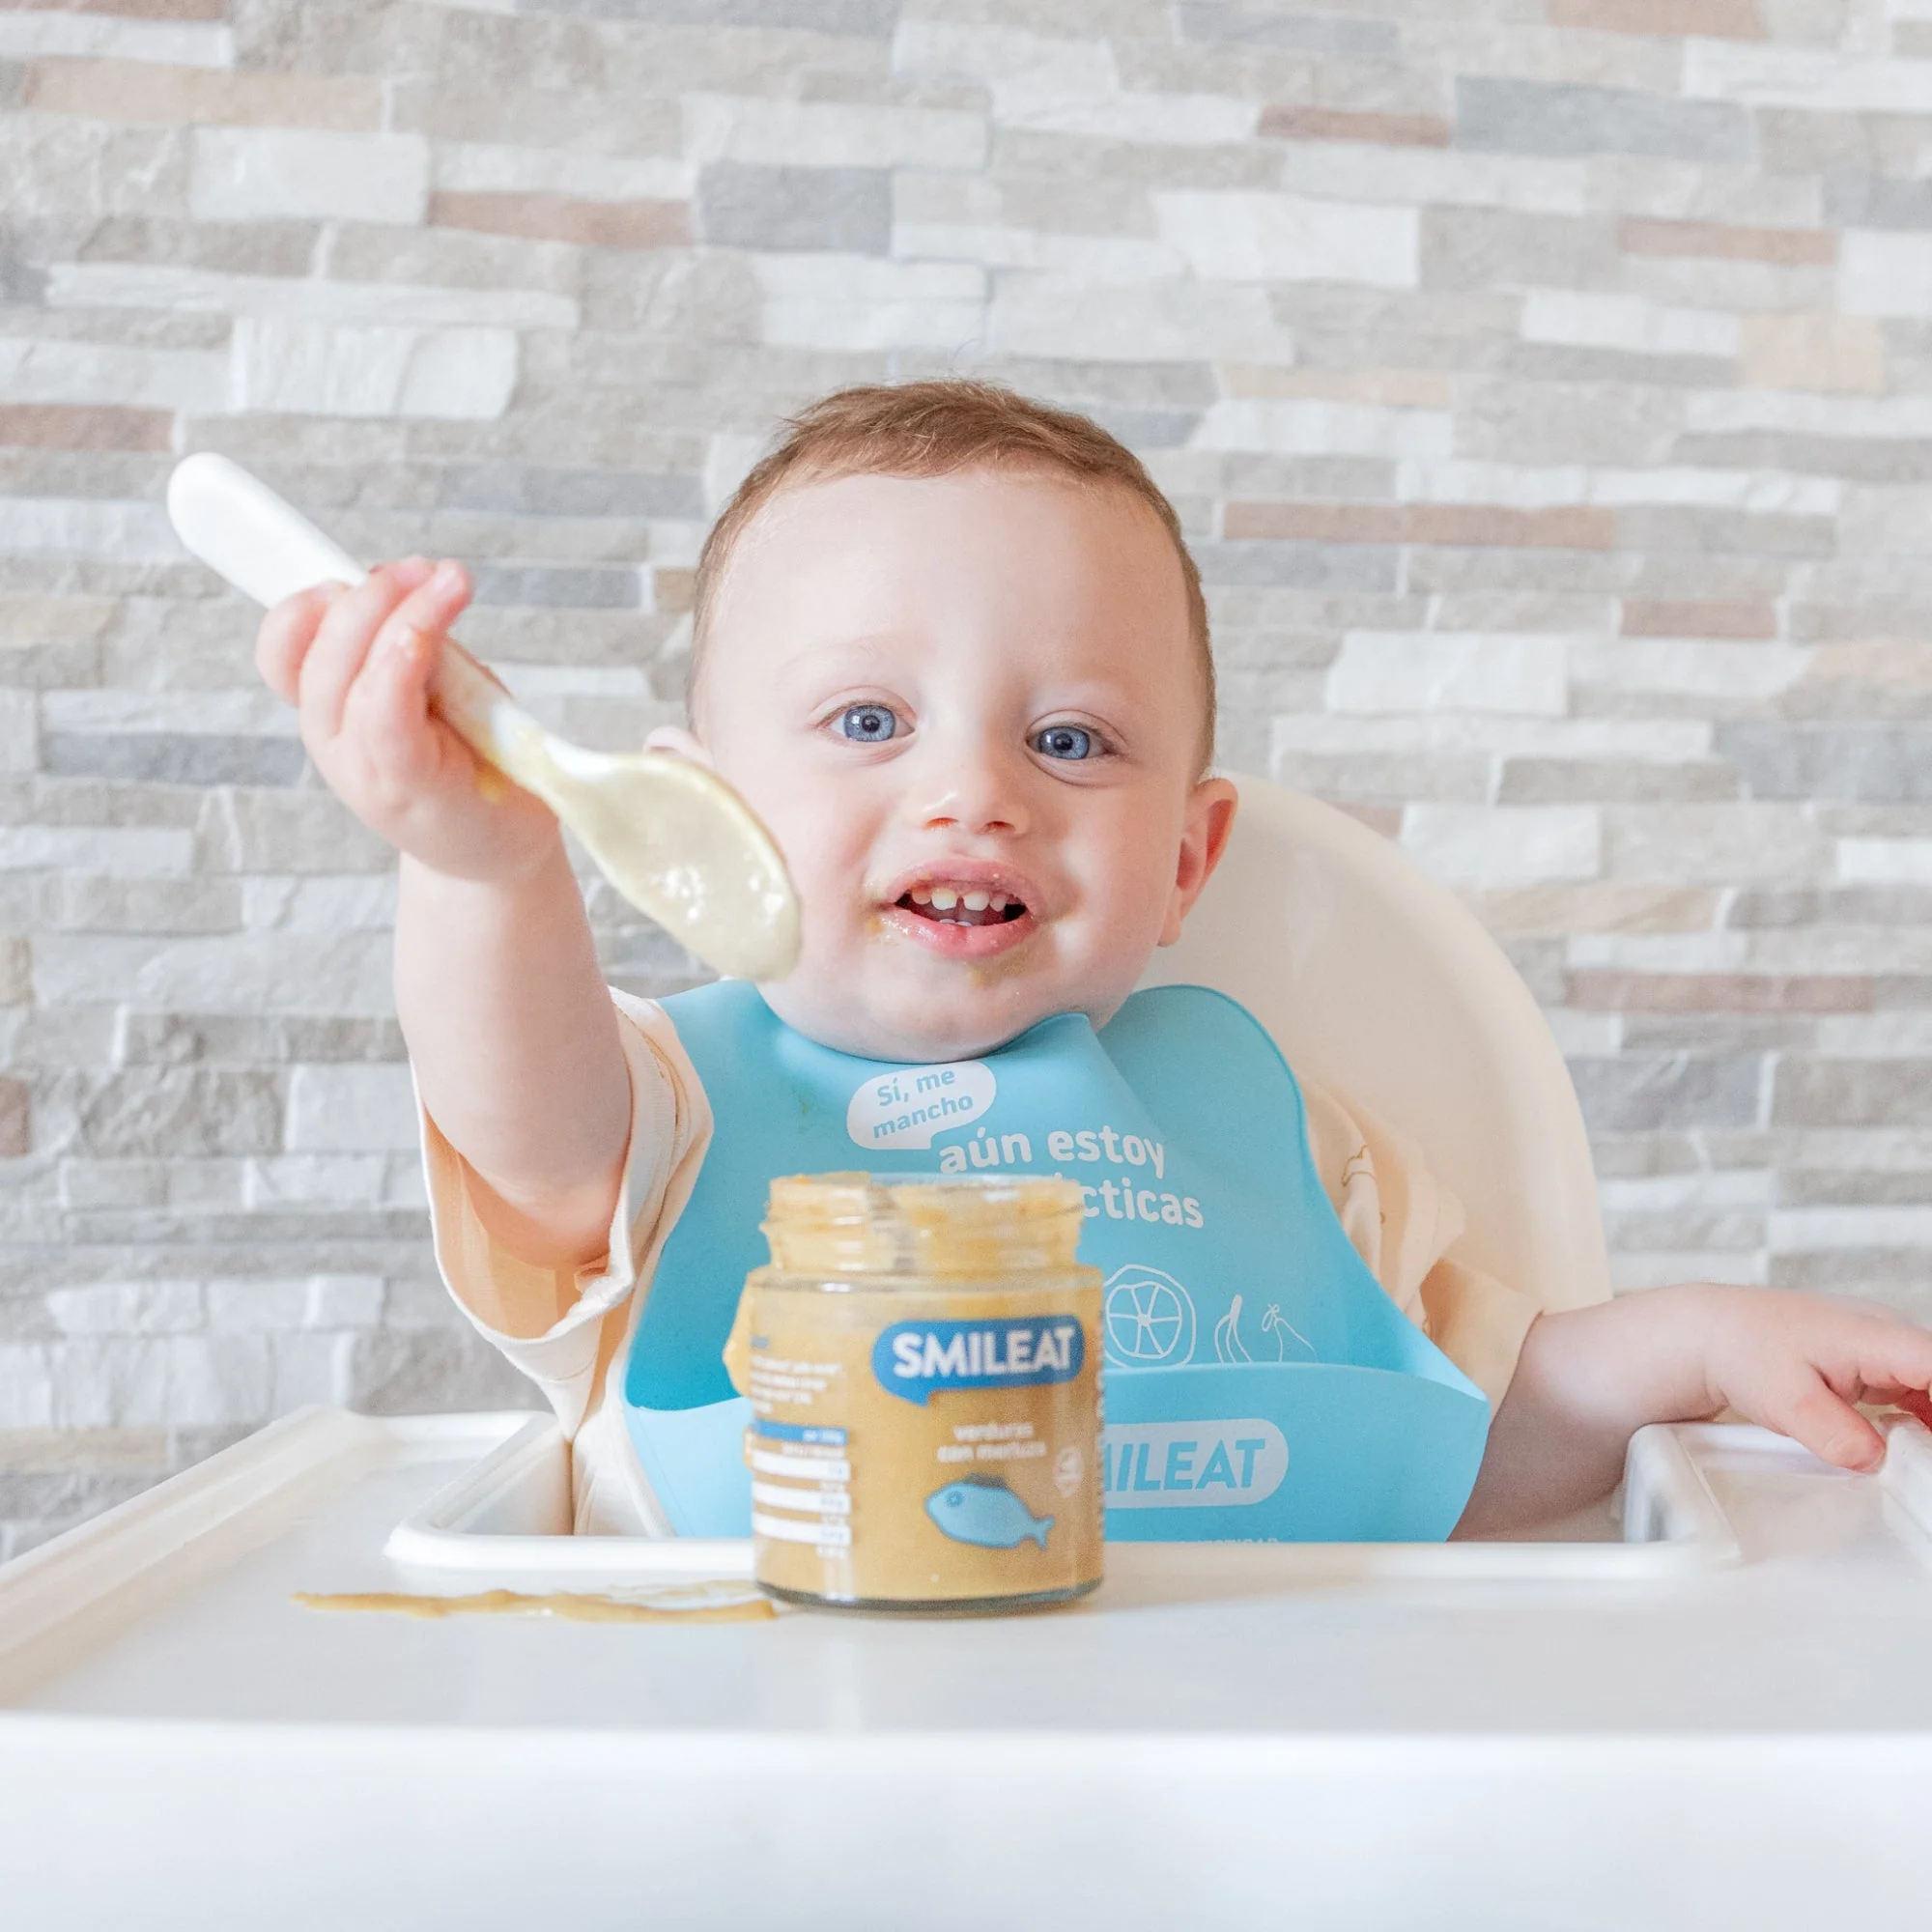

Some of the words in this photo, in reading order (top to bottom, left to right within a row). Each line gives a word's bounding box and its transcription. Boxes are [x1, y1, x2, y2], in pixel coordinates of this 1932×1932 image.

[877, 1077, 909, 1106] Sí,
[916, 1070, 955, 1094] me
[873, 1095, 974, 1139] mancho
[939, 1126, 1033, 1174] aún
[1047, 1125, 1165, 1179] estoy
[1054, 1172, 1204, 1228] cticas
[892, 1326, 1075, 1378] SMILEAT
